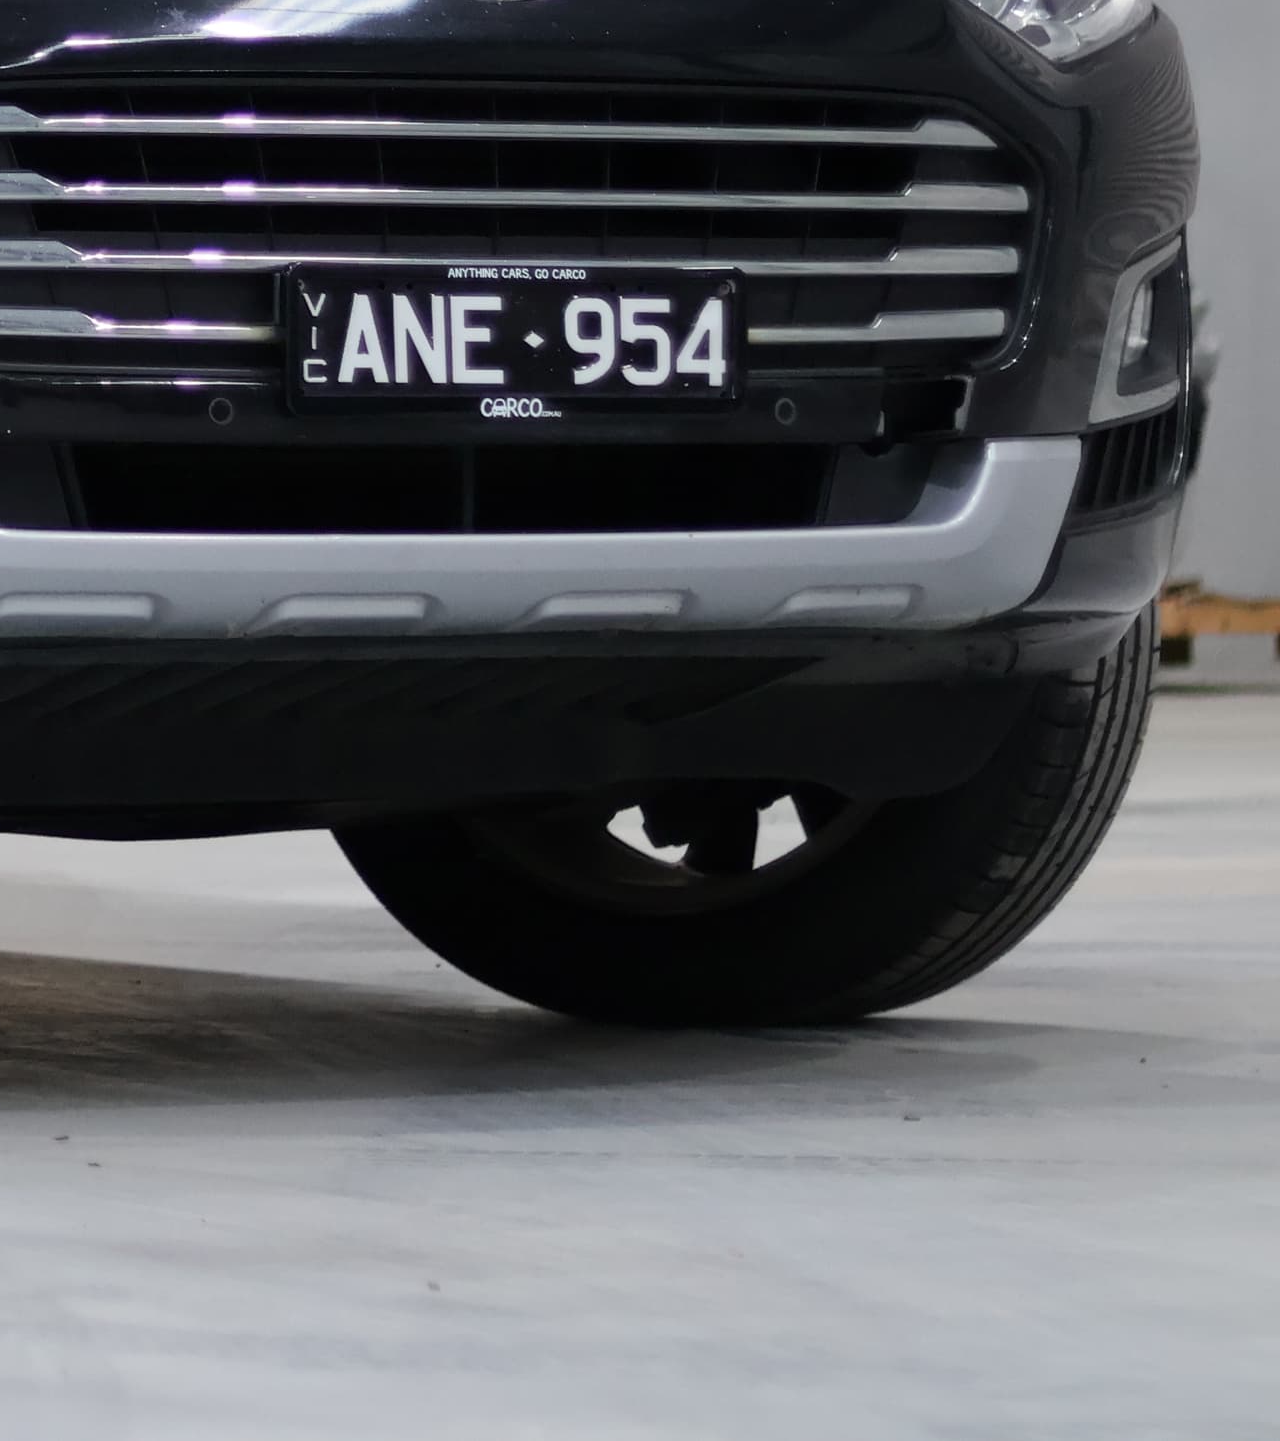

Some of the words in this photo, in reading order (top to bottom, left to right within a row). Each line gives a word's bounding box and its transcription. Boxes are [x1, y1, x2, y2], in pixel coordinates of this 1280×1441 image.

[447, 267, 499, 279] ANYTHING
[500, 267, 533, 280] CARS,
[534, 268, 549, 280] GO
[551, 268, 587, 280] CARCO
